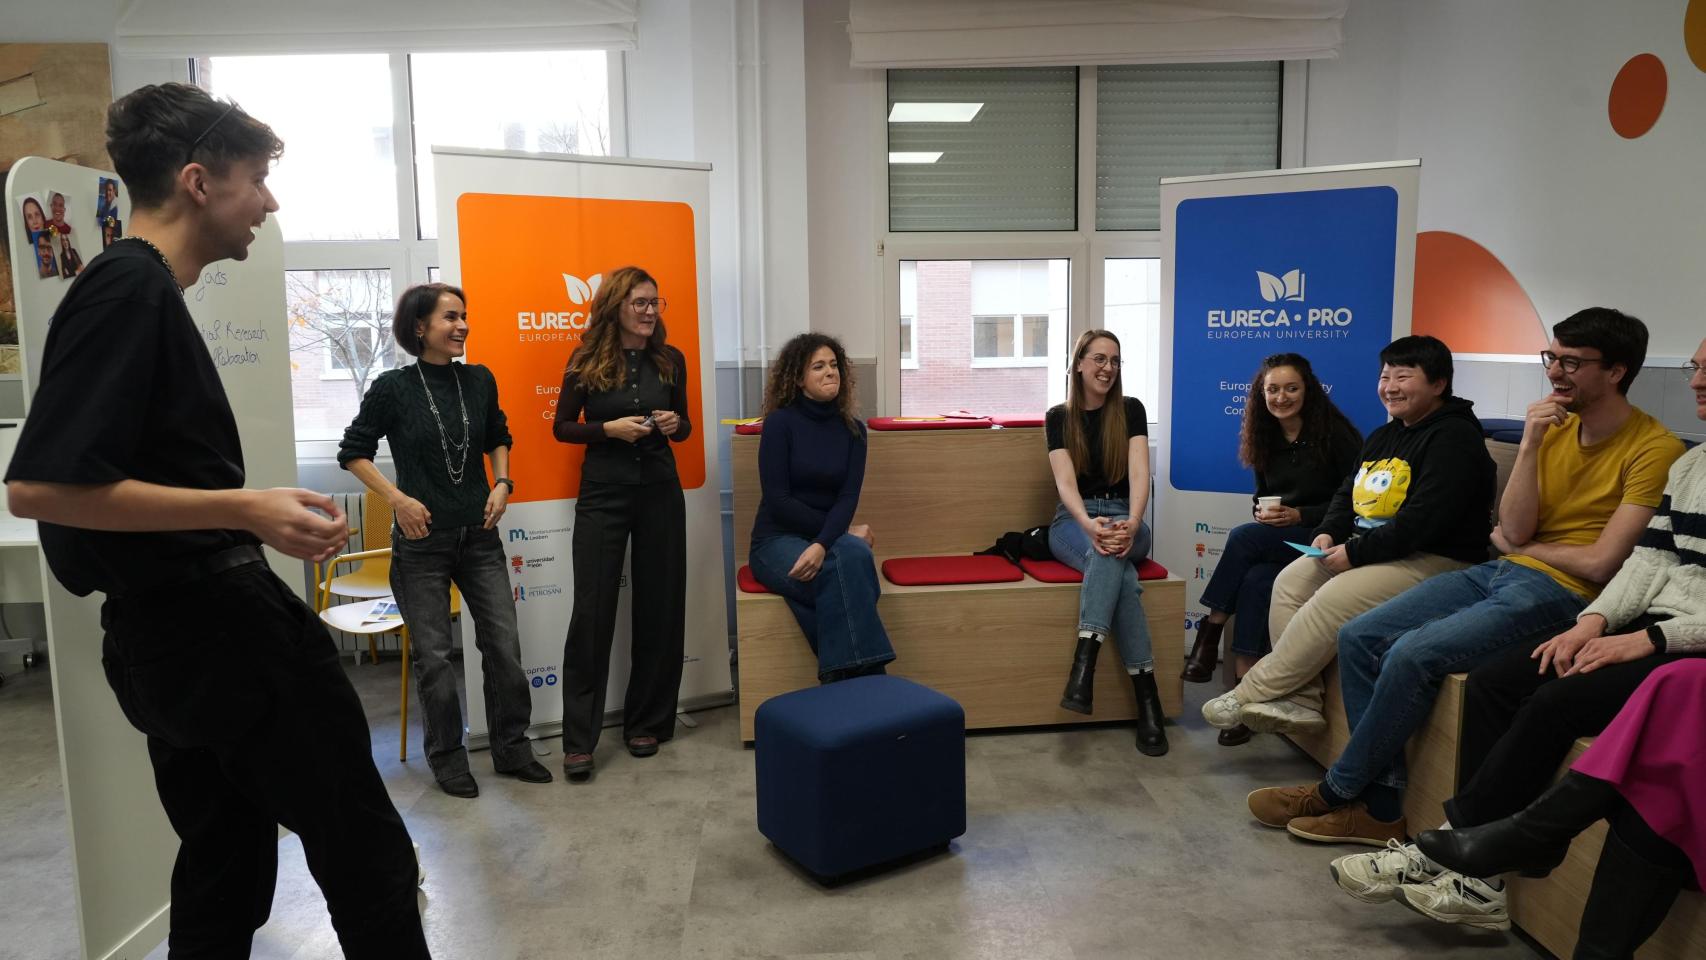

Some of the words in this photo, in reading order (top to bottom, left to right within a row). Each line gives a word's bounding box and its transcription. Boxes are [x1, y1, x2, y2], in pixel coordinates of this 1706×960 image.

[1207, 309, 1290, 328] EURECA
[1308, 307, 1353, 326] PRO
[519, 333, 581, 342] EUROPEAN
[1207, 330, 1270, 339] EUROPEAN
[1276, 329, 1350, 339] UNIVERSITY
[535, 385, 560, 395] Euro
[1220, 381, 1253, 393] Europ
[1232, 395, 1247, 403] on
[1224, 405, 1246, 415] Con
[526, 665, 557, 675] apro.eu
